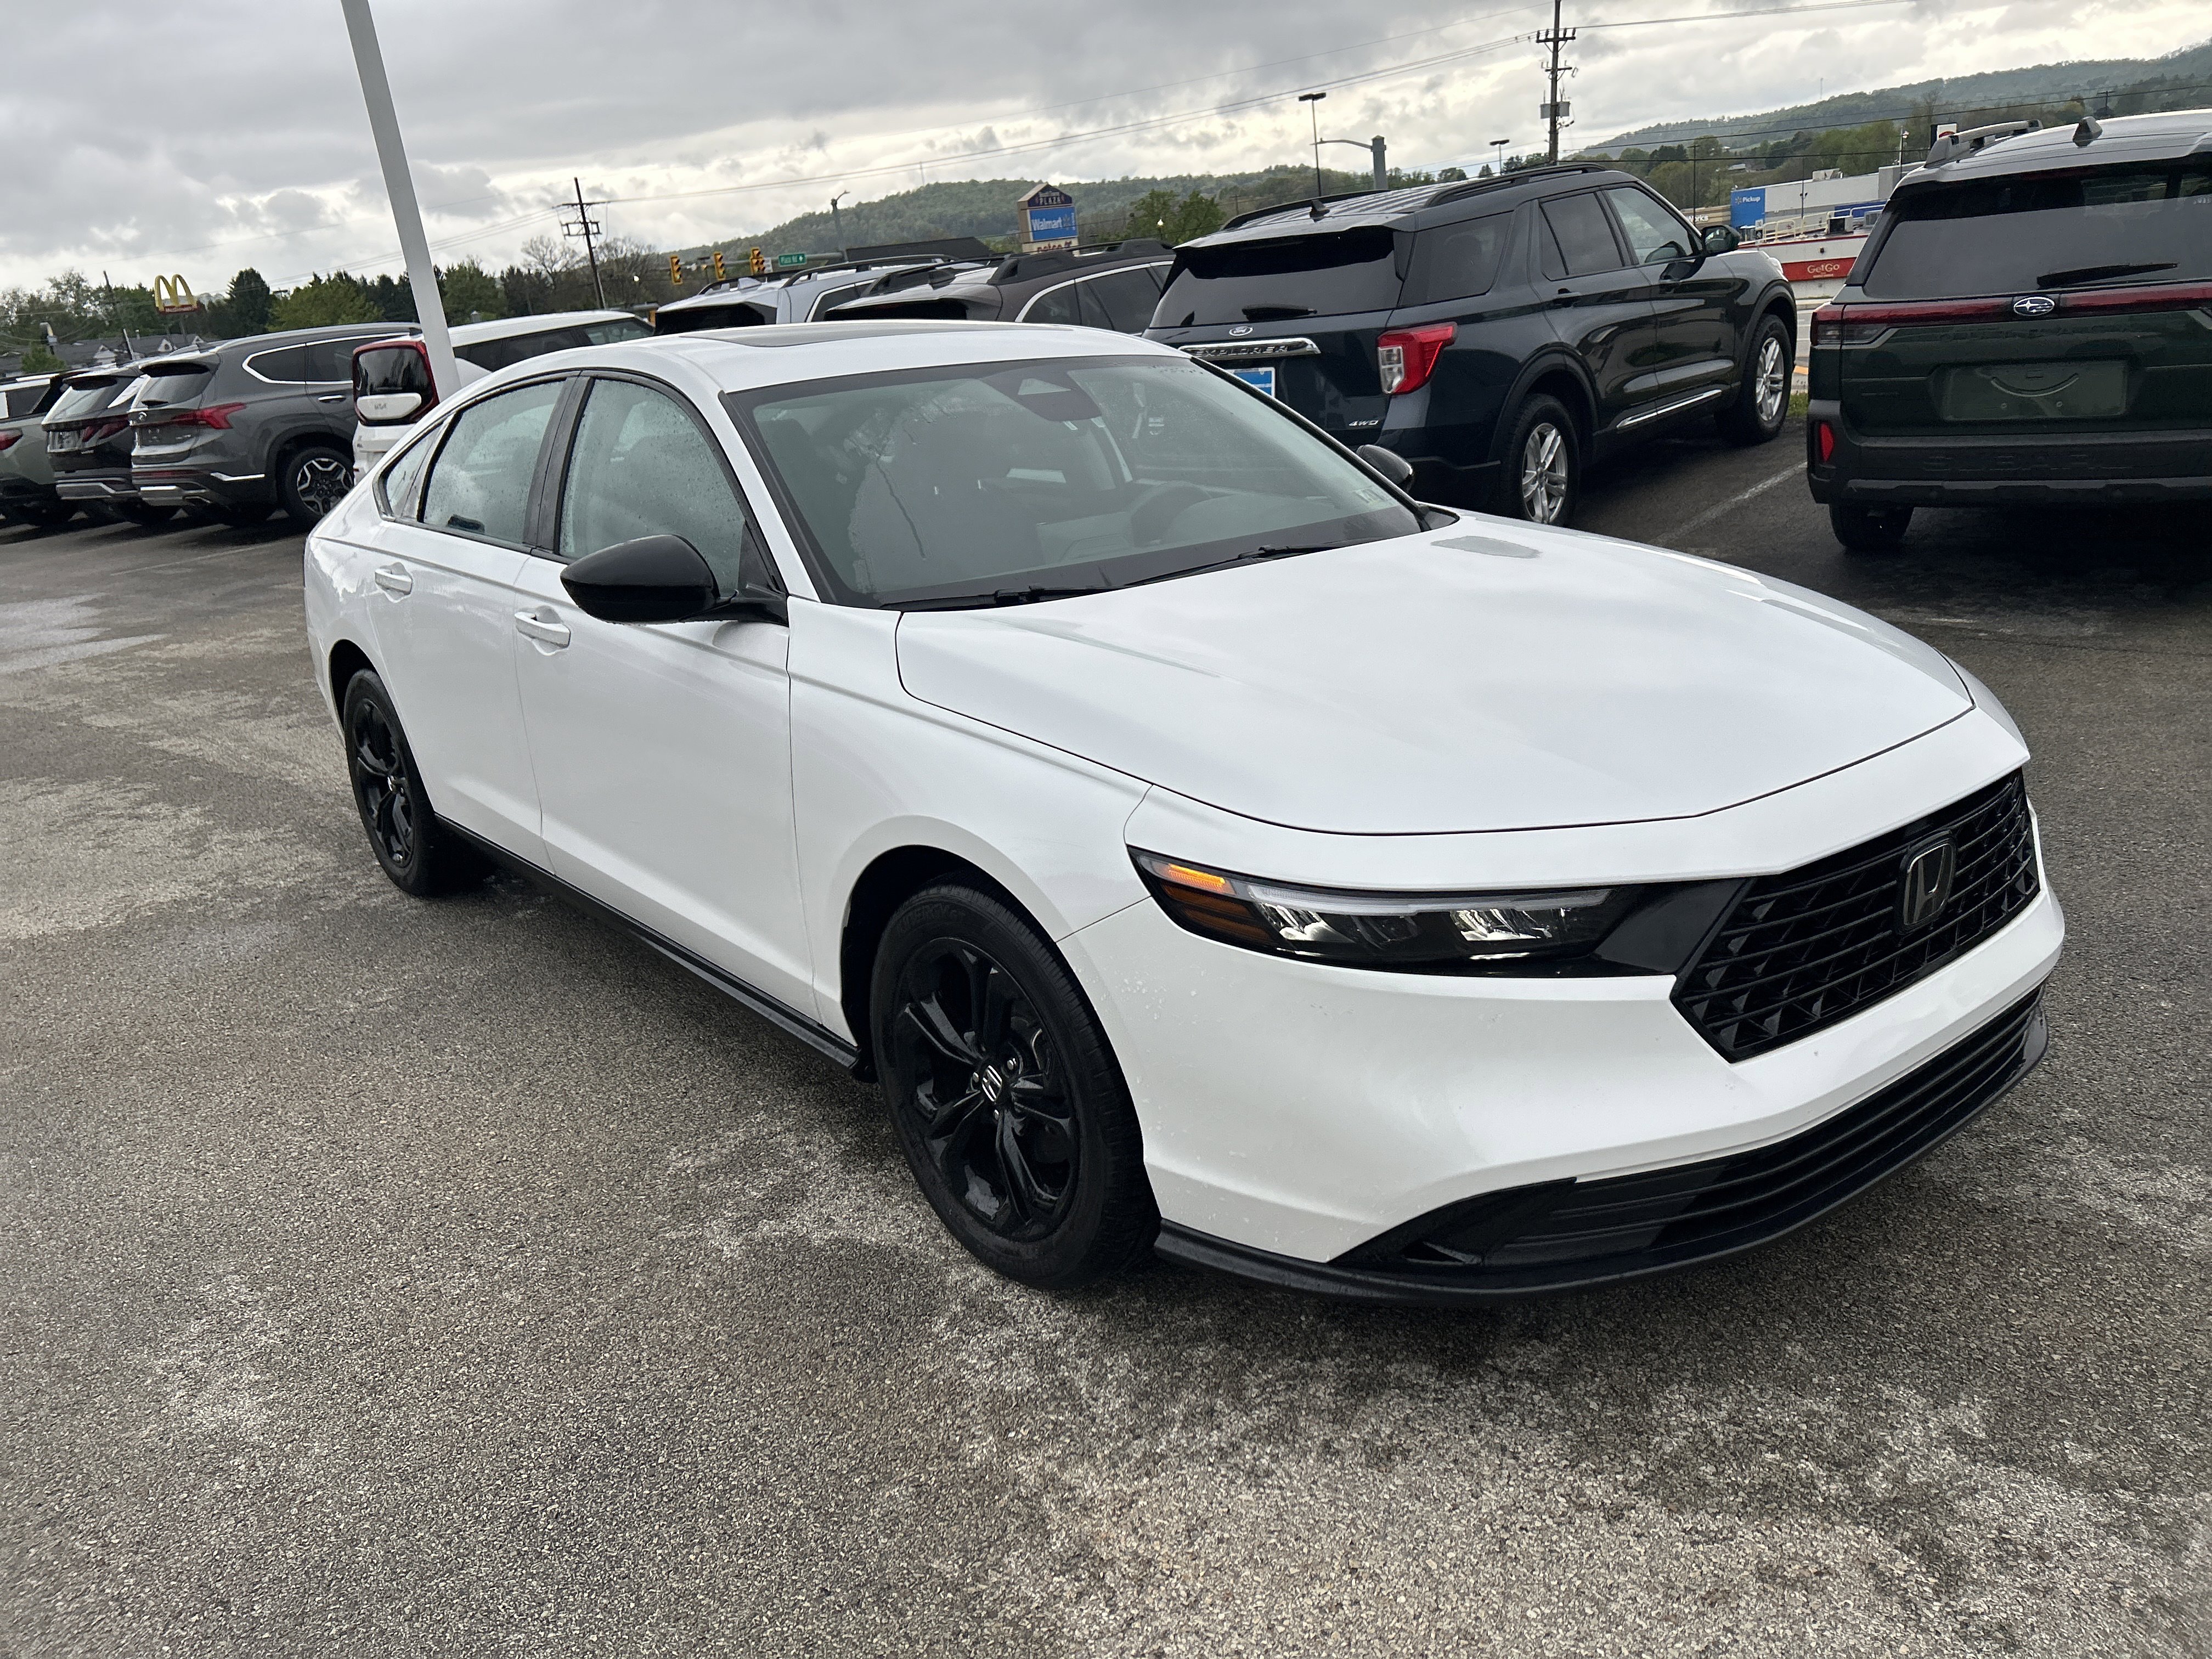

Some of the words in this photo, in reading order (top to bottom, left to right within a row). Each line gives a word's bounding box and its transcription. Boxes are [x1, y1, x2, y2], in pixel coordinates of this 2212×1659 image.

[1031, 217, 1062, 230] Walmart
[1807, 263, 1839, 274] GetGo
[1195, 346, 1289, 357] EXPLORER
